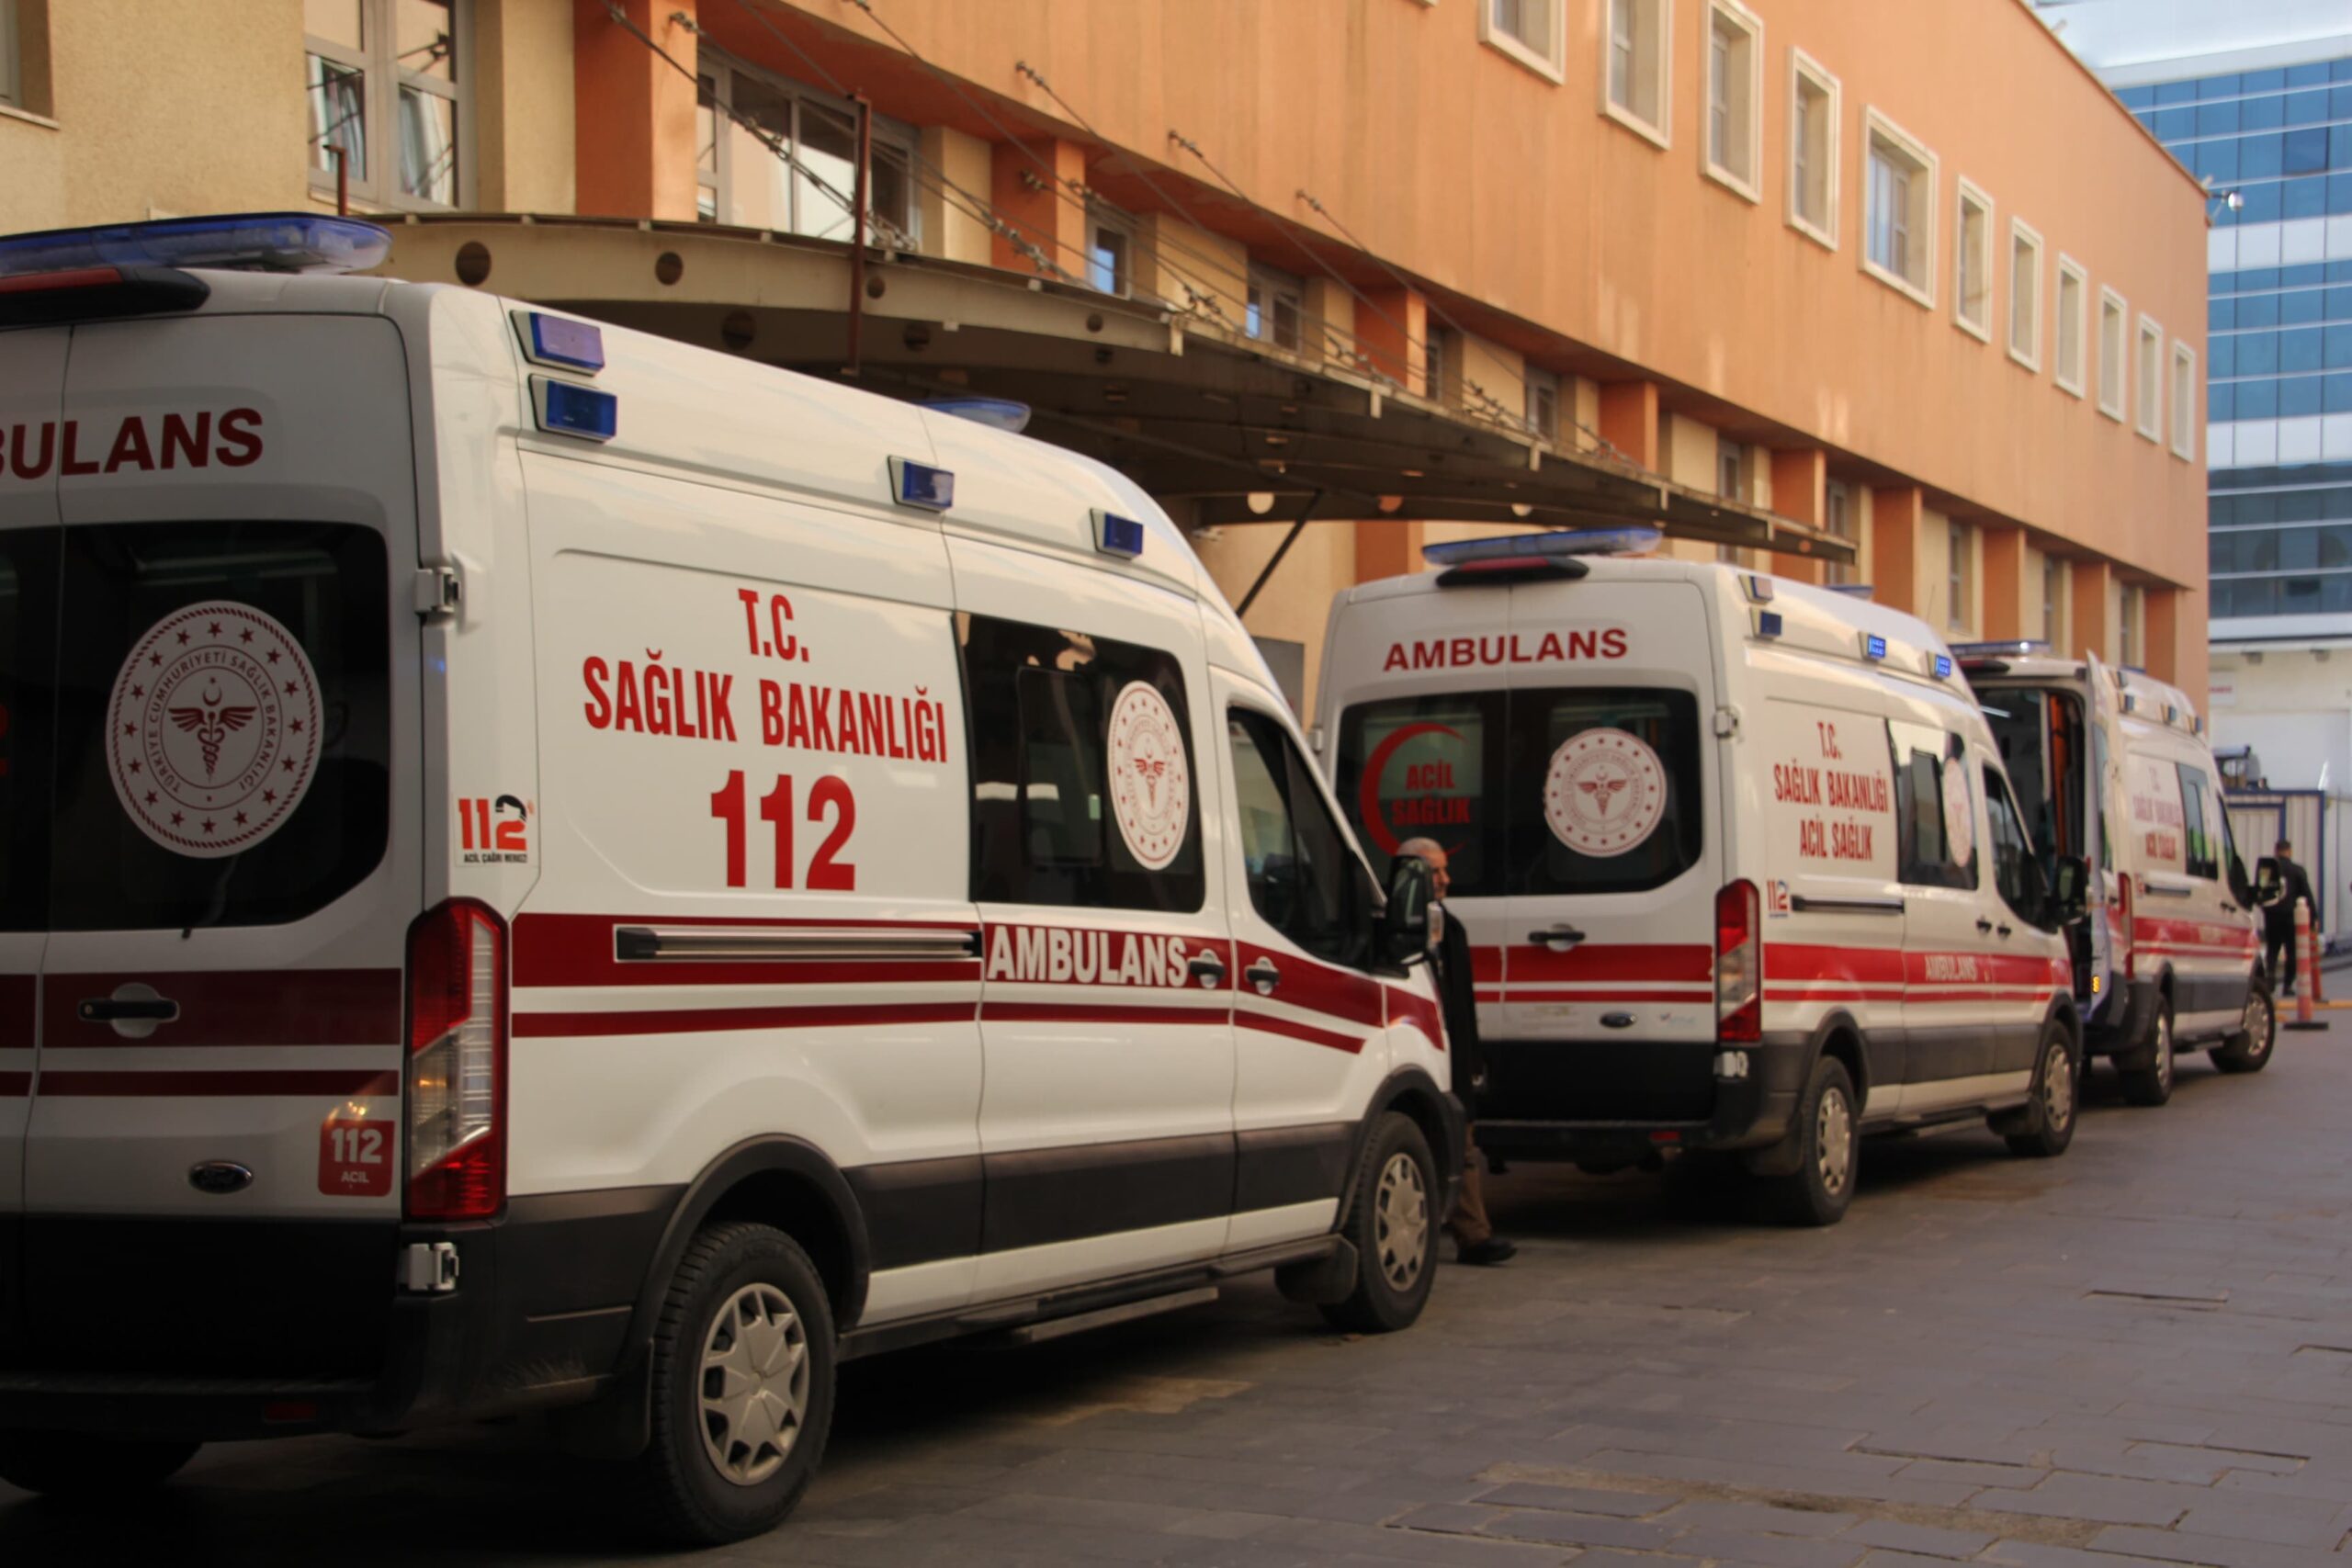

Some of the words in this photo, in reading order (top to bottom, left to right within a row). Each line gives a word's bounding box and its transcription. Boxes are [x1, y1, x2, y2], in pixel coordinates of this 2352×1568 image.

[0, 408, 264, 479] ULANS
[738, 588, 809, 662] T.C.
[1383, 627, 1629, 672] AMBULANS
[149, 650, 227, 723] CUMHURİYETİ
[232, 655, 272, 700] SAĞLIK
[582, 648, 737, 742] SAĞLIK
[759, 679, 947, 763] BAKANLIĞI
[238, 705, 277, 791] BAKANLIĞI
[1817, 721, 1842, 760] T.C.
[1405, 757, 1455, 790] ACİL
[1773, 758, 1821, 806] SAĞLIK
[1826, 770, 1889, 814] BAKANLIĞI
[458, 795, 527, 852] 112
[709, 769, 855, 892] 112
[1391, 794, 1471, 826] SAĞLIK
[1800, 813, 1827, 859] ACİL
[1832, 816, 1872, 862] SAĞLIK
[1767, 880, 1789, 912] 112
[987, 925, 1188, 987] AMBULANS
[331, 1128, 383, 1164] 112
[341, 1169, 369, 1184] ACİL
